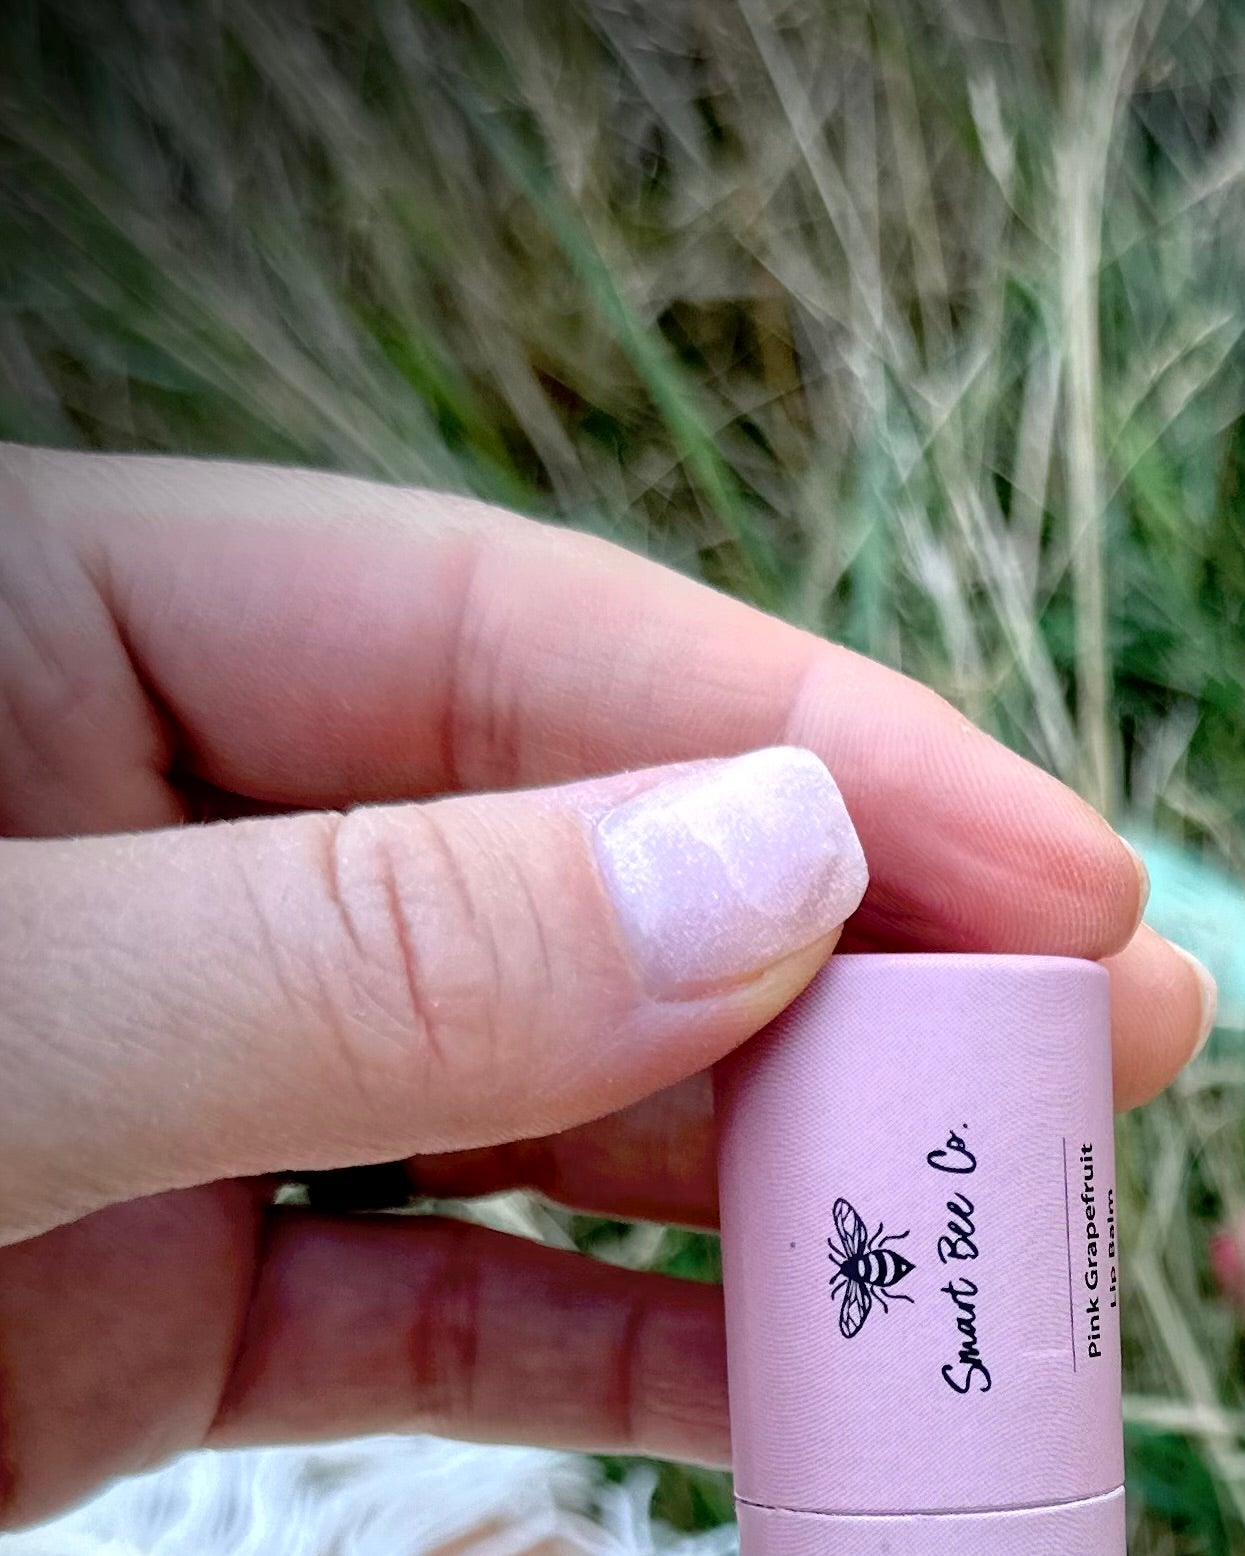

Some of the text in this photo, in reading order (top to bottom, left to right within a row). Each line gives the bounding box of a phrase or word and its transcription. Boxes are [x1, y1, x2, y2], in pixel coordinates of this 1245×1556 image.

[926, 1123, 992, 1394] Smart Bee Co.
[1080, 1143, 1102, 1358] Pink Grapefruit
[1106, 1189, 1115, 1258] Balm
